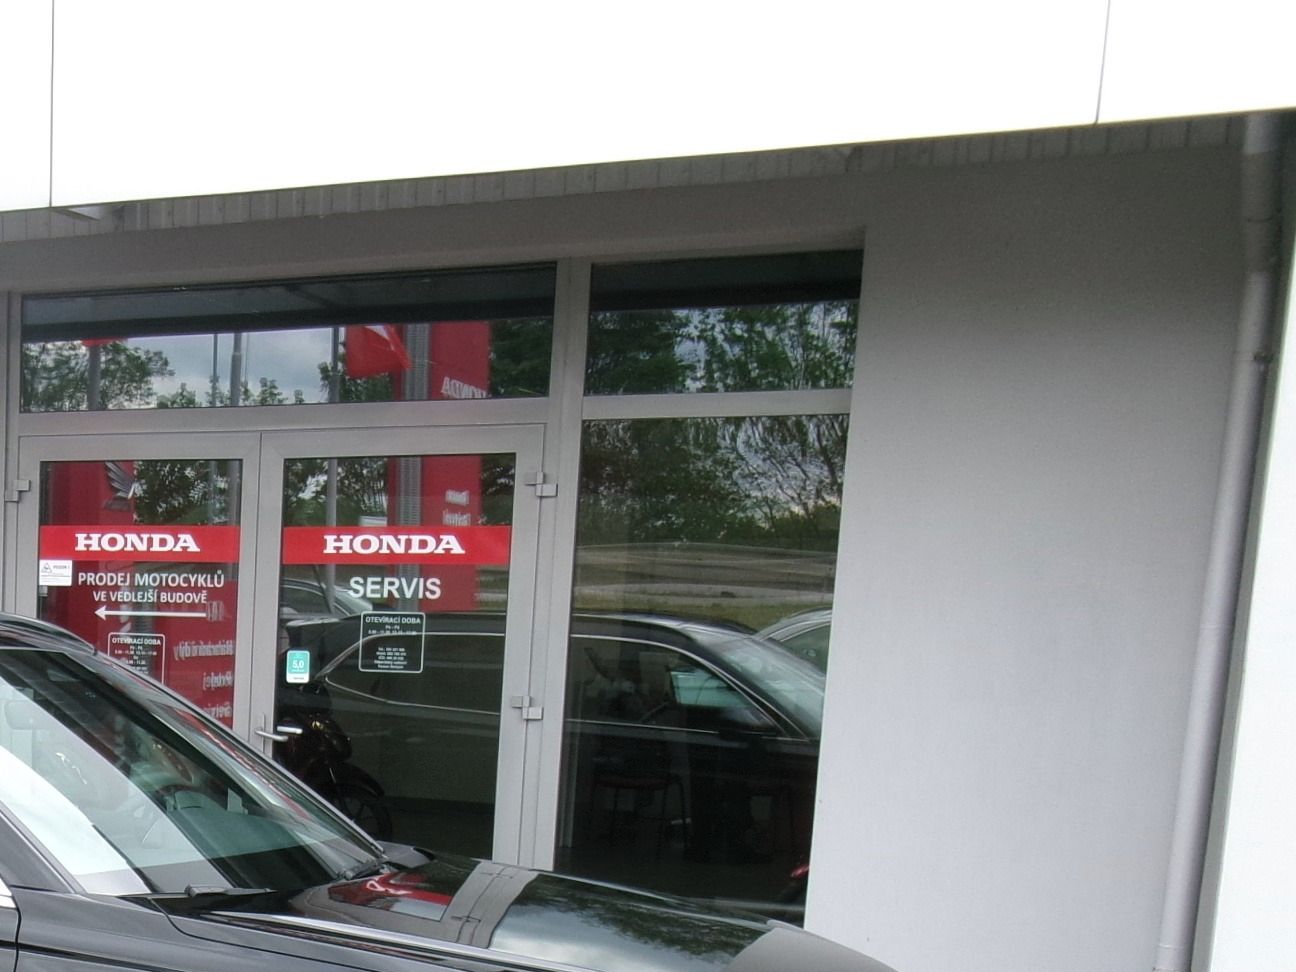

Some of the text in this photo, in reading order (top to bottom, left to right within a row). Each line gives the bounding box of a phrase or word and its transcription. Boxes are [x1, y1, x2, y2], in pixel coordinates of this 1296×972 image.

[75, 533, 201, 552] HONDA
[323, 534, 466, 554] HONDA
[78, 572, 130, 586] PRODEJ
[134, 569, 225, 588] MOTOCYKLŮ
[349, 576, 442, 600] SERVIS
[93, 589, 208, 604] VE VEDLEJŠÍ BUDOVĚ
